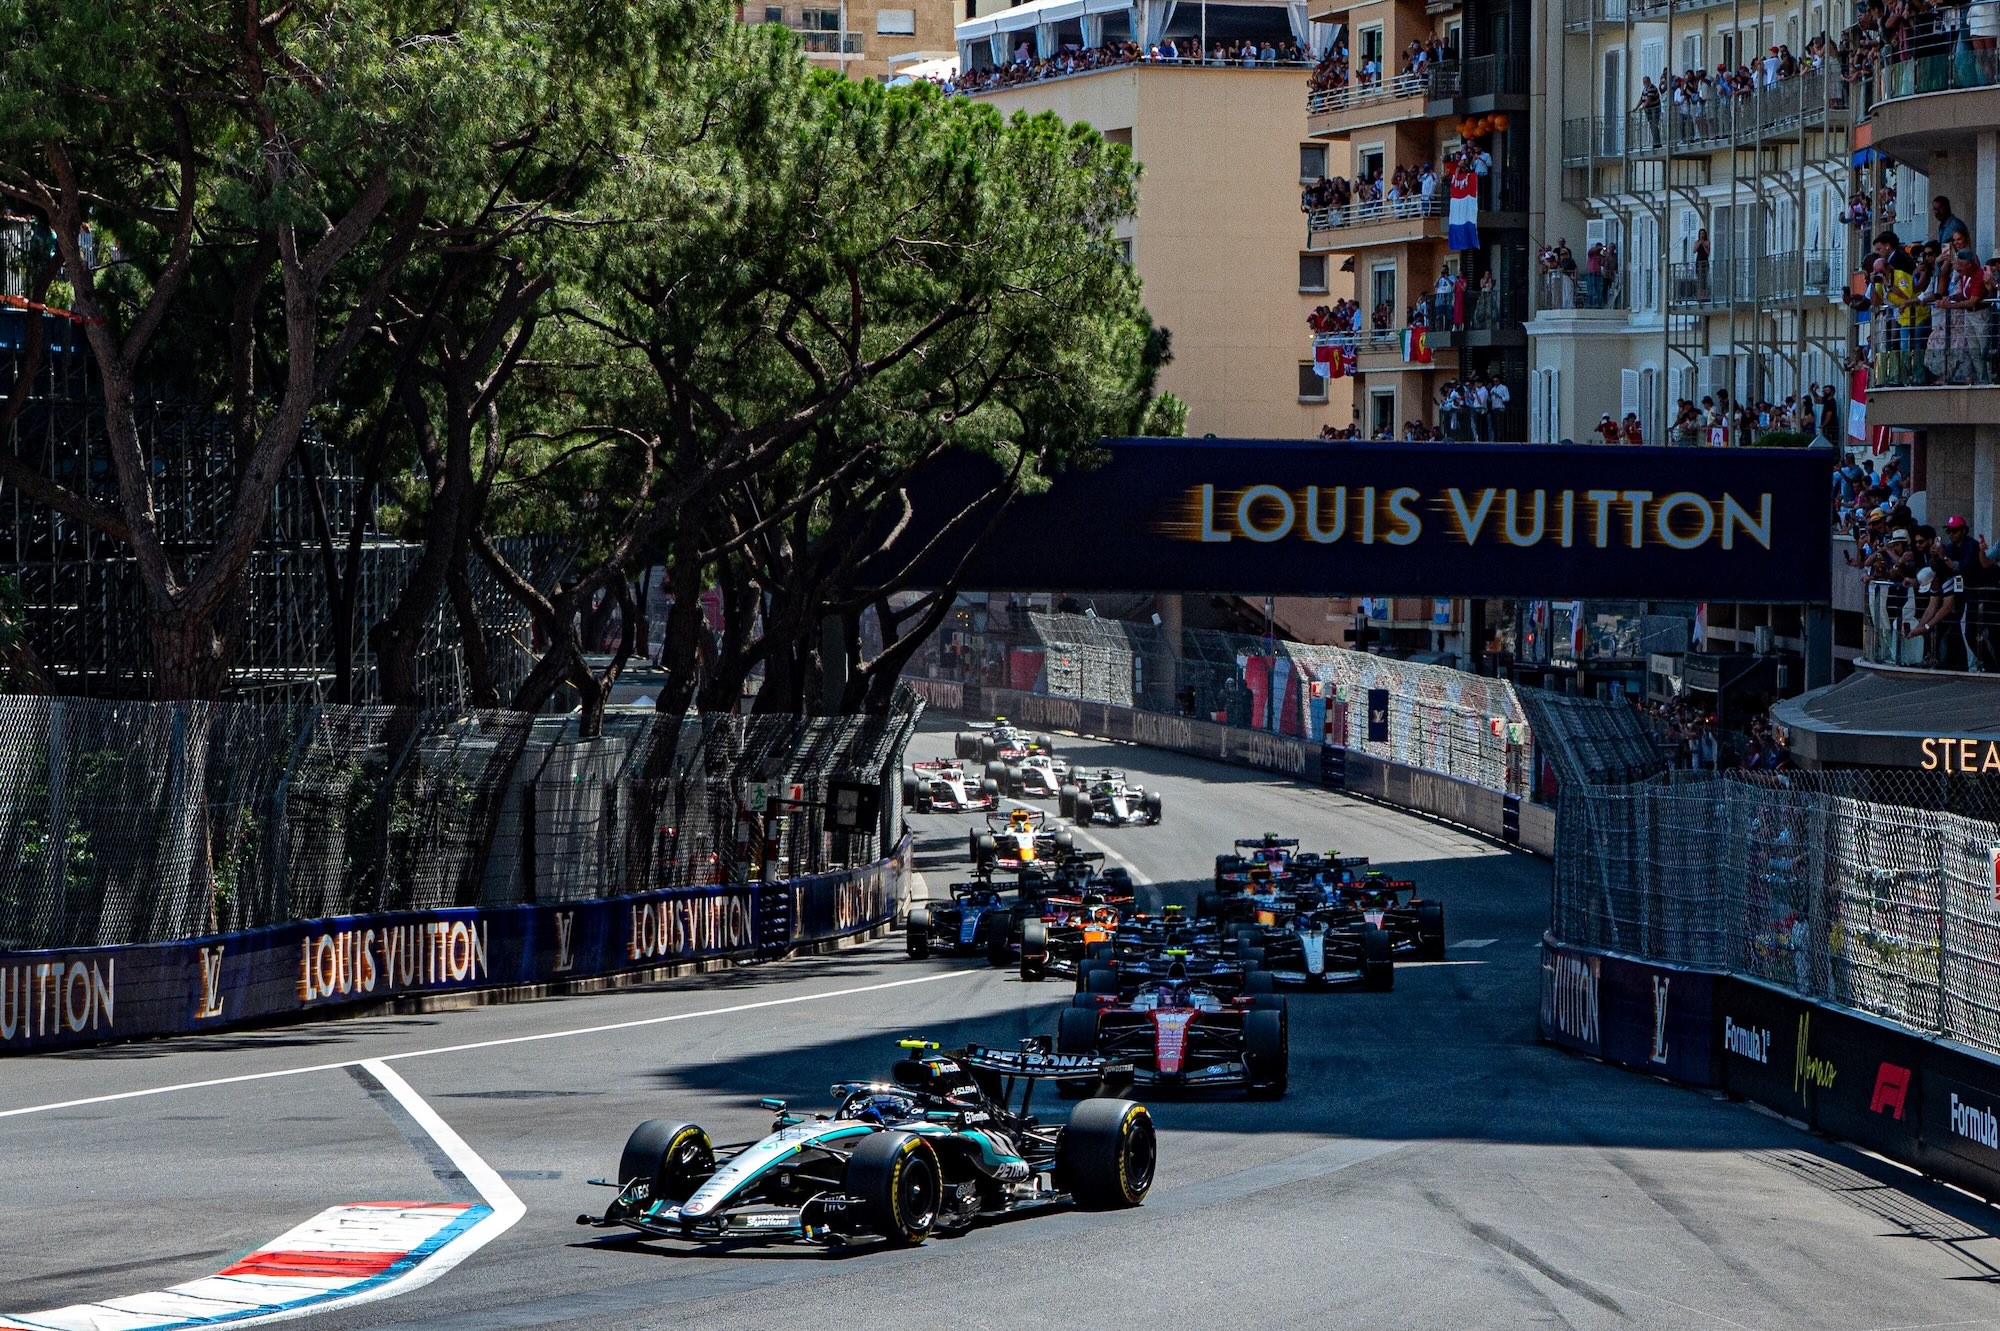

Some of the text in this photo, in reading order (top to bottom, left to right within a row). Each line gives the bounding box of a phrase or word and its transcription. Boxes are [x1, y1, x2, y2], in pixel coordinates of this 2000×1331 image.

[1202, 484, 1772, 550] LOUIS VUITTON
[1020, 697, 1081, 729] LOUIS VUITTON
[1132, 712, 1192, 748] LOUIS VUITTON
[1250, 735, 1305, 774] LOUIS VUITTON
[1921, 738, 2000, 773] STEA
[1411, 772, 1467, 819] LOUIS VUITTON
[631, 894, 752, 960] LOUIS VUITTON
[304, 919, 488, 1000] LOUIS VUITTON
[1553, 954, 1600, 1046] VUITTON
[986, 1049, 1107, 1071] PETRONAS
[1724, 1015, 1760, 1062] Formula
[1794, 1011, 1837, 1109] Monaco
[1103, 1063, 1134, 1073] CROWDSTRIKE
[1950, 1092, 1999, 1150] Formula
[746, 1217, 790, 1227] Syntium
[823, 1194, 847, 1213] IWC
